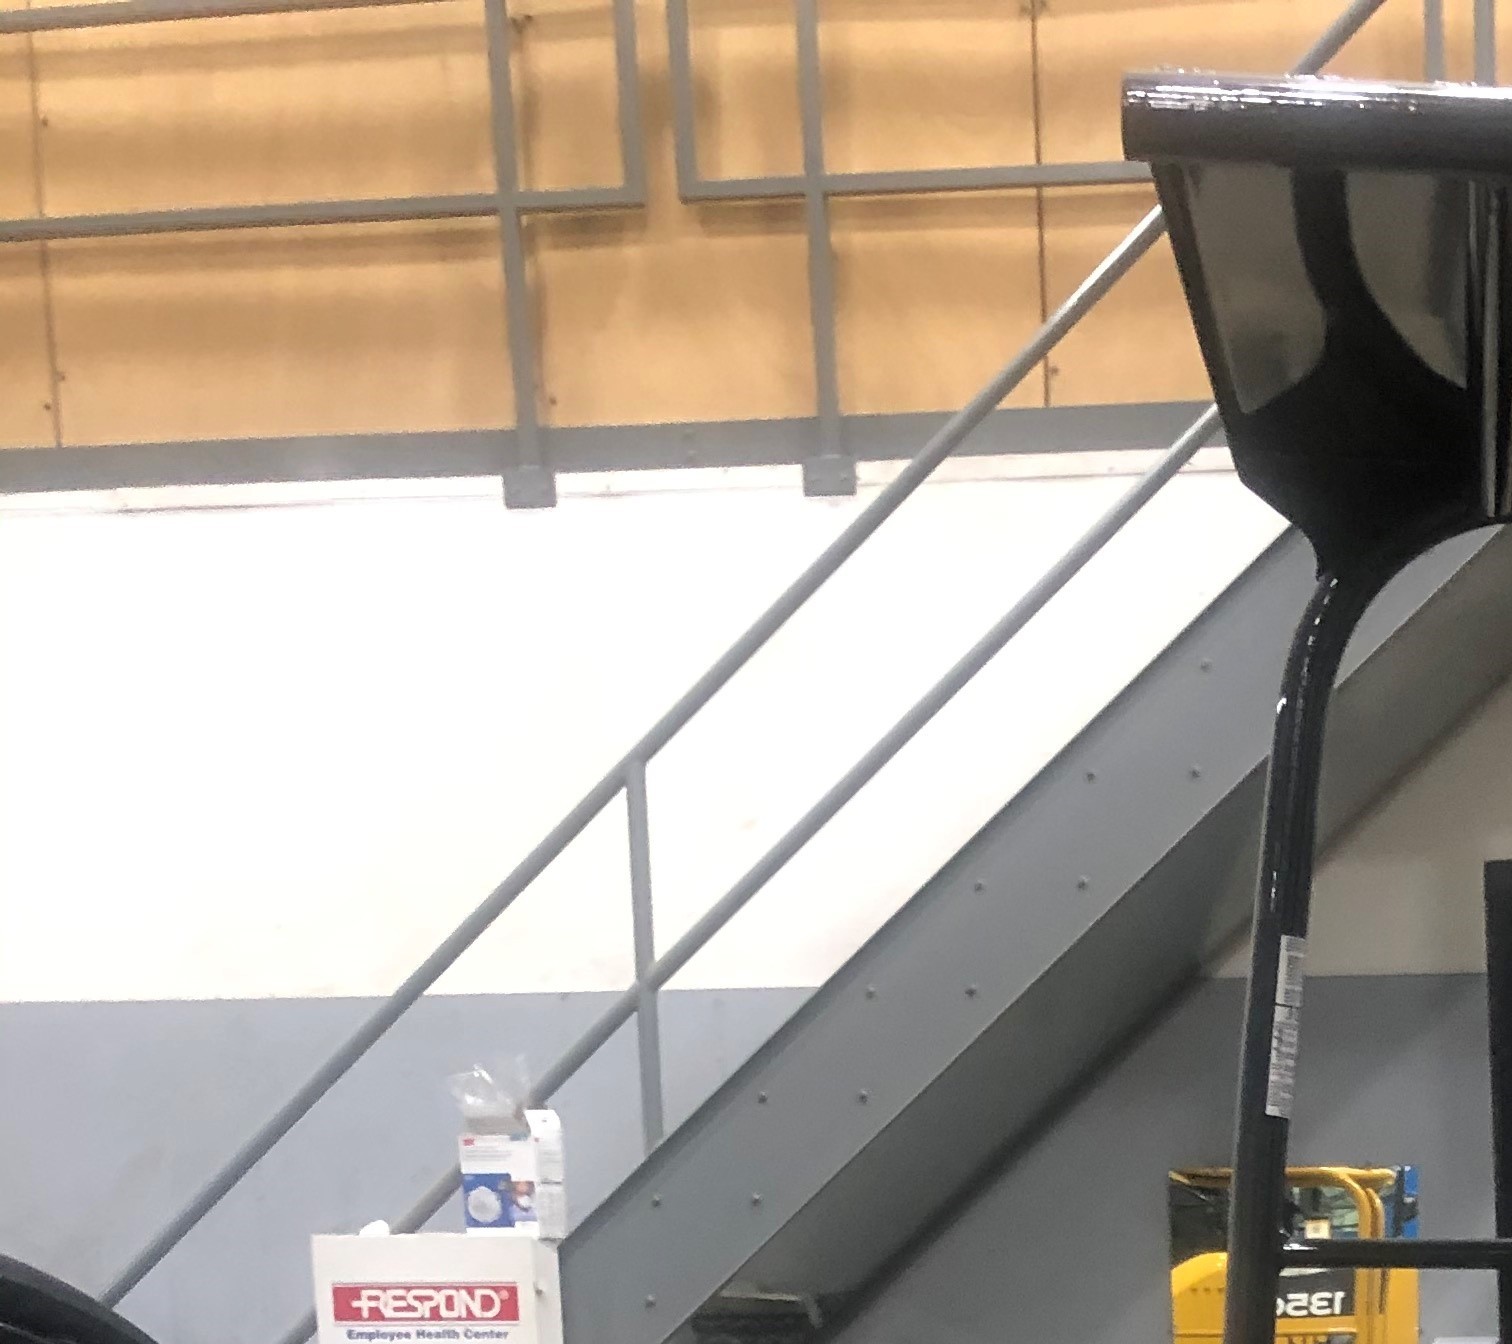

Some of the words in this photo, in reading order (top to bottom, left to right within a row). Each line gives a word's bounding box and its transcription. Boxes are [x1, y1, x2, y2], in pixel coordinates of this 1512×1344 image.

[352, 1289, 501, 1318] RESPOND
[346, 1329, 411, 1341] Employee
[416, 1329, 460, 1339] Health
[464, 1329, 509, 1339] Center
